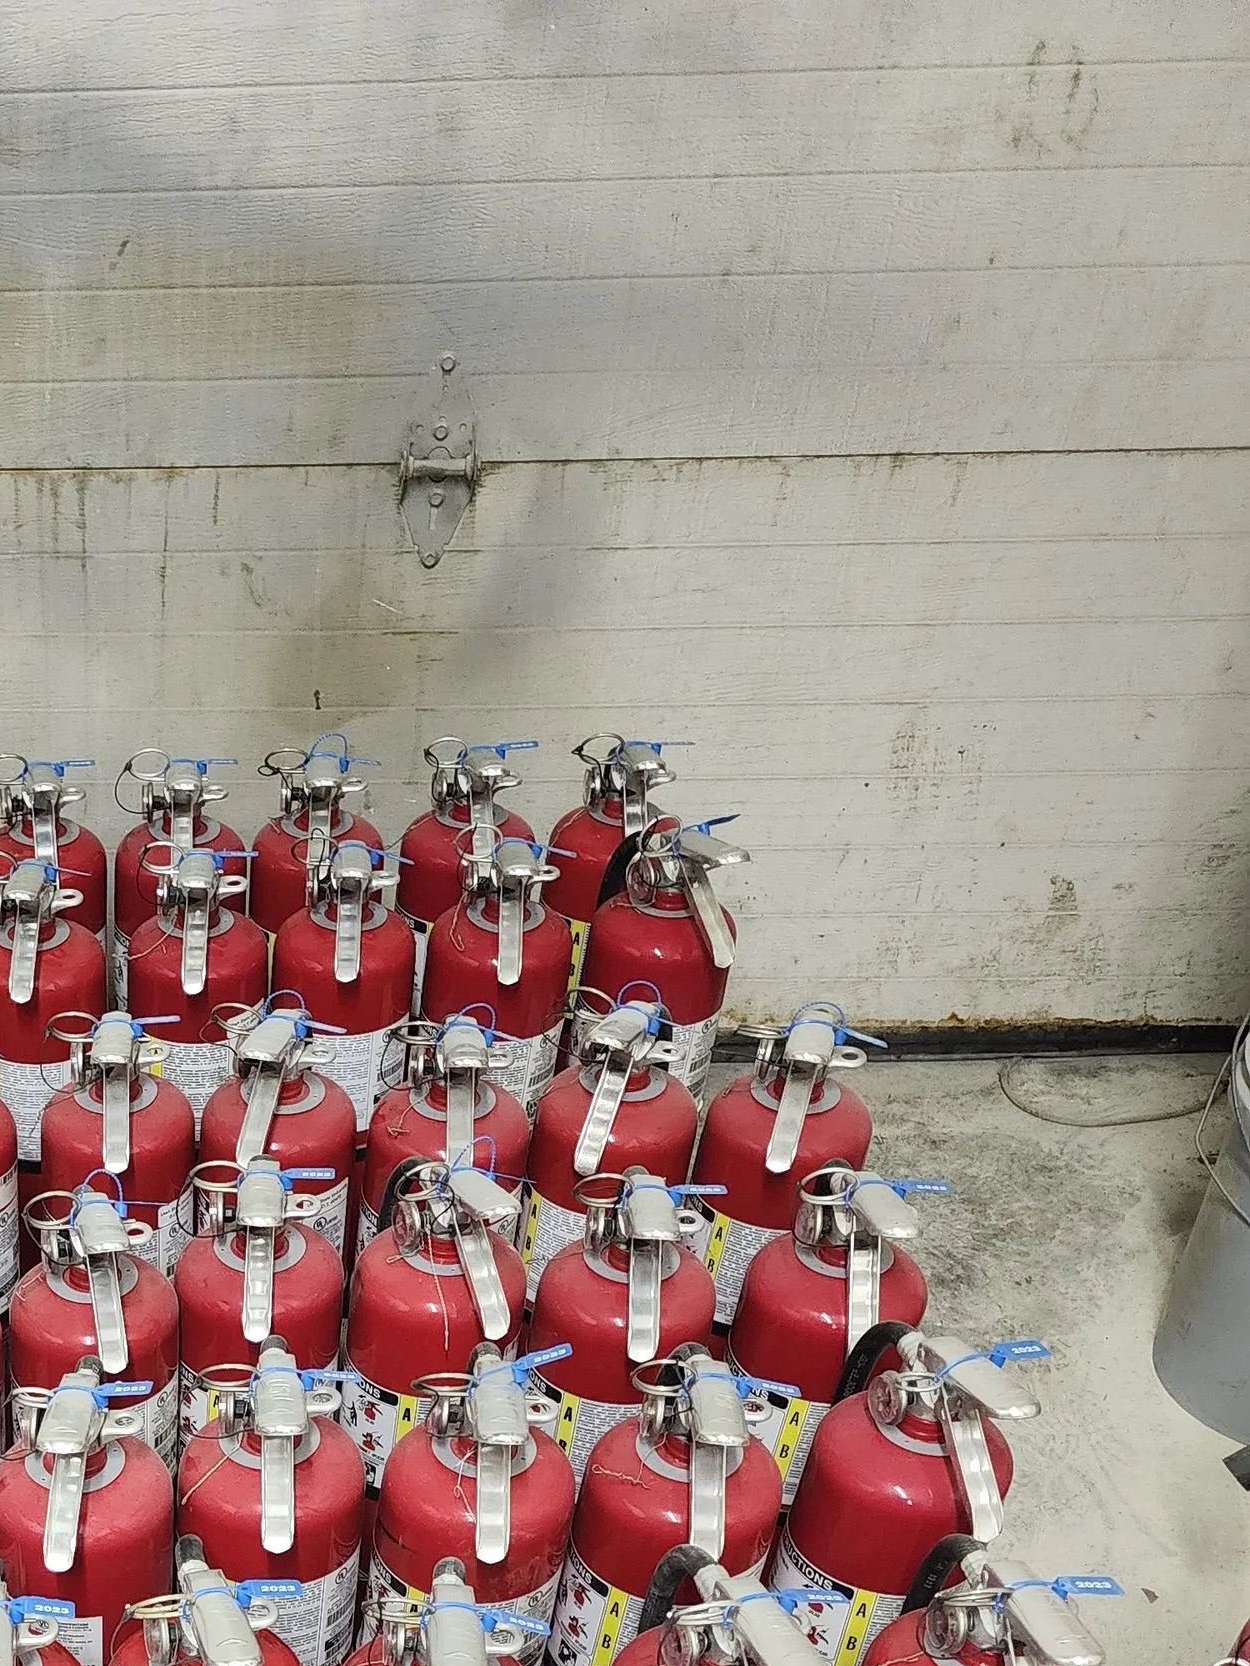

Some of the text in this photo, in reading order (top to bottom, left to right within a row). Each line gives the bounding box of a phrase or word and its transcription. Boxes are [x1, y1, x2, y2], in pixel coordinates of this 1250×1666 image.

[530, 1204, 537, 1219] A
[714, 1226, 723, 1243] A
[524, 1236, 532, 1251] B
[706, 1258, 715, 1274] B
[1010, 1344, 1042, 1355] 2023
[113, 1385, 147, 1393] 2023
[401, 1407, 411, 1422] A
[563, 1406, 573, 1422] A
[789, 1411, 799, 1426] A
[779, 1444, 790, 1459] B
[260, 1584, 296, 1593] 2023
[1074, 1580, 1111, 1590] 2023
[34, 1603, 70, 1615] 2023
[610, 1602, 619, 1617] A
[855, 1602, 866, 1618] A
[602, 1634, 611, 1649] B
[846, 1636, 857, 1651] B
